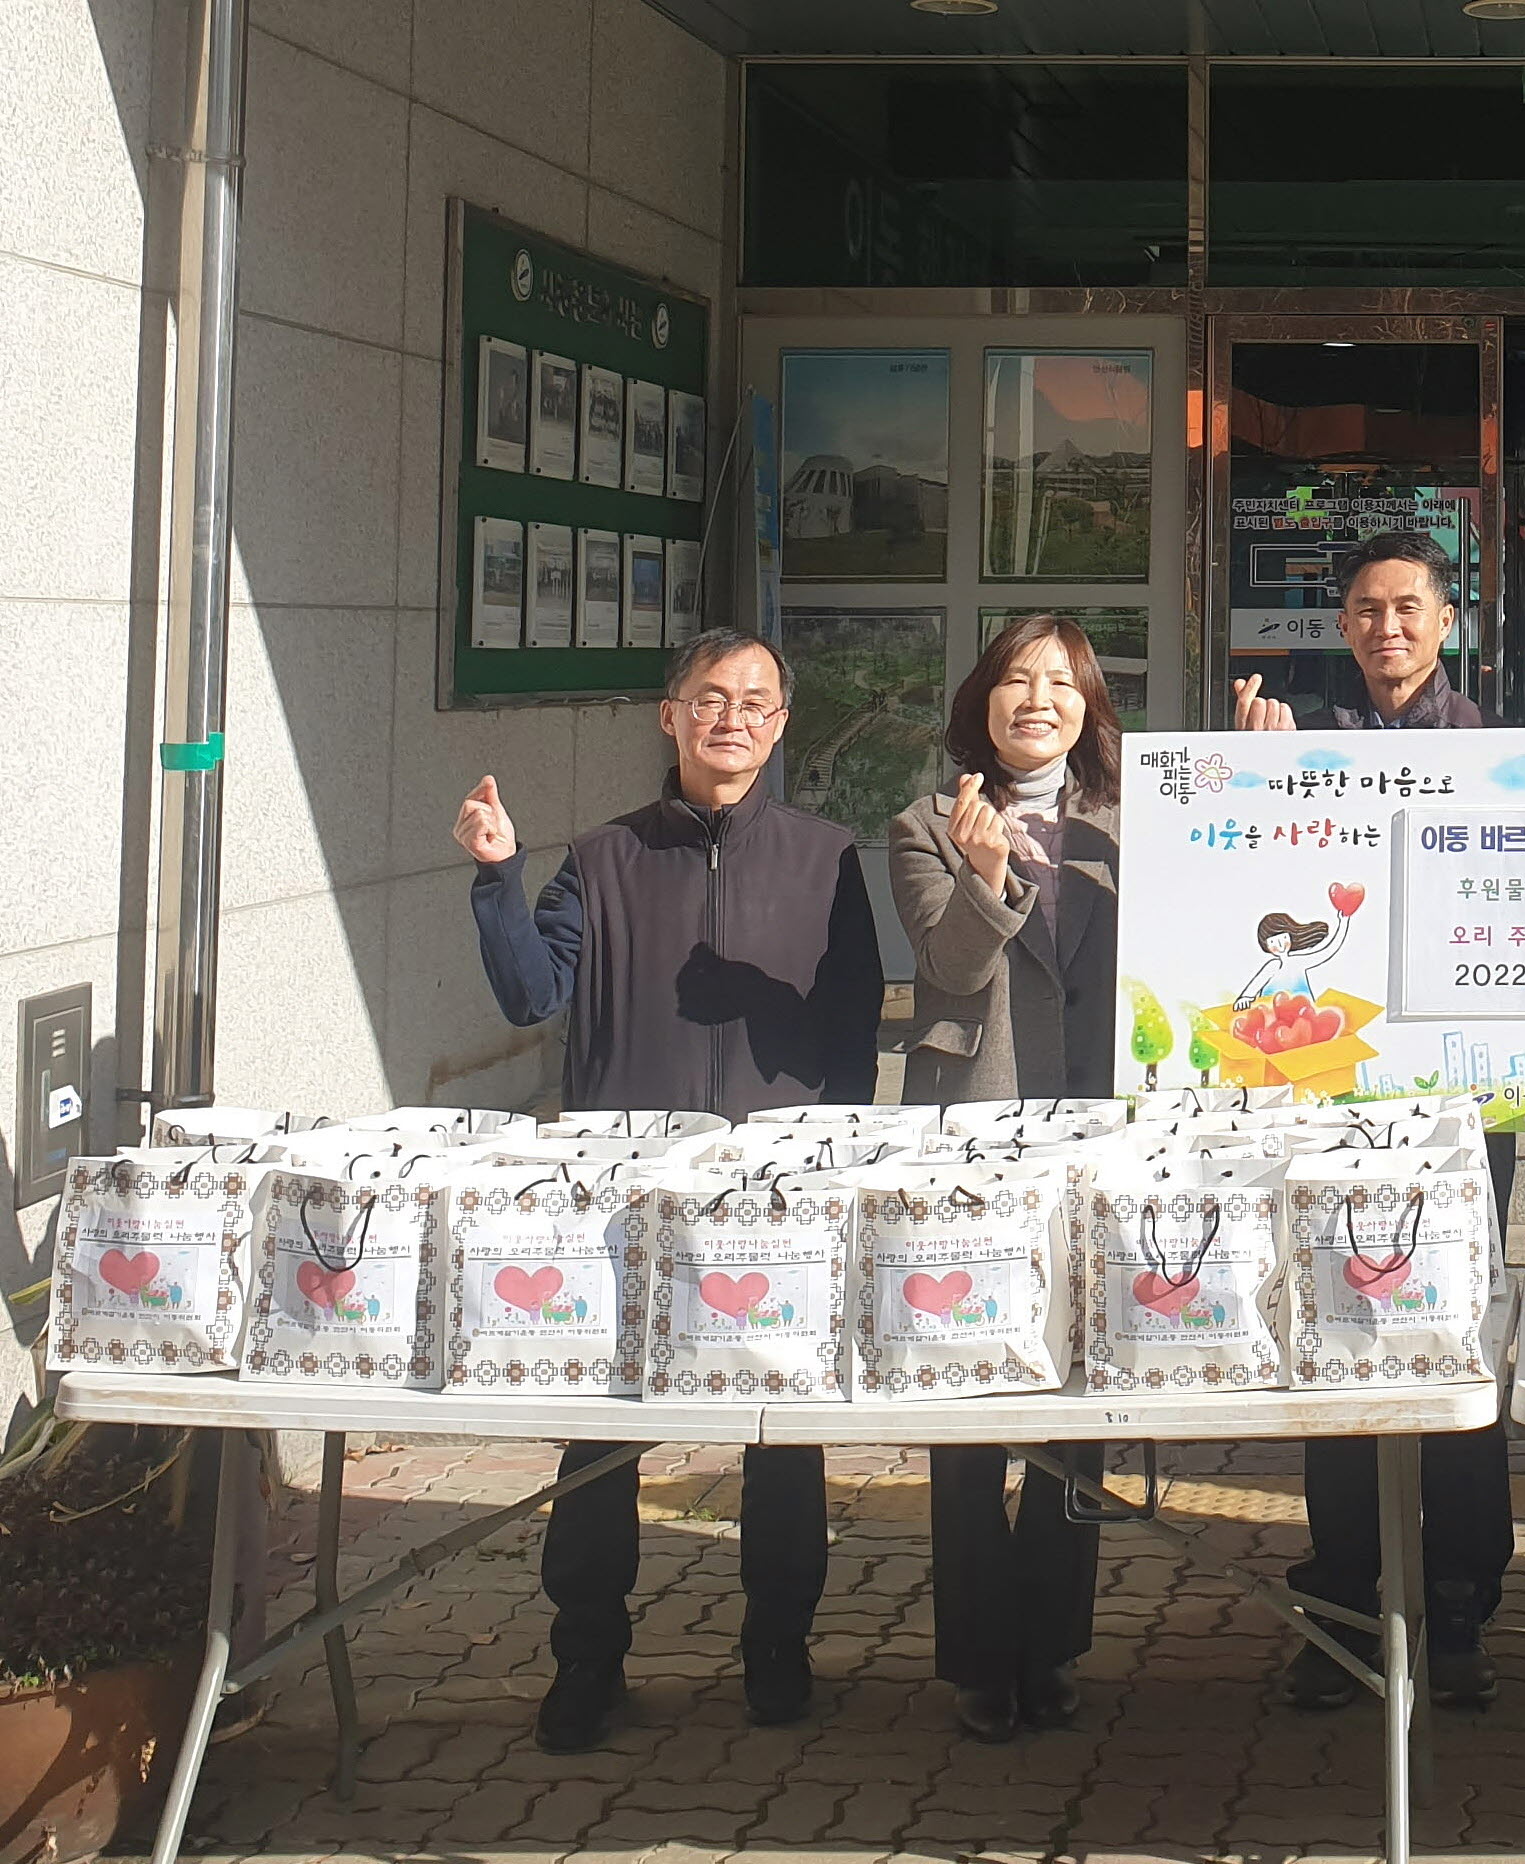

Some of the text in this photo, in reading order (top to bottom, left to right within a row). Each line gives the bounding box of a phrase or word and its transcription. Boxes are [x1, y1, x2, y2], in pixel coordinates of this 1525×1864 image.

[1232, 499, 1299, 513] 주민자치센터
[1304, 499, 1348, 512] 프로그램
[1234, 516, 1269, 529] 표시된
[1349, 516, 1403, 530] 이용하시기
[1287, 619, 1325, 638] 이동
[1140, 746, 1191, 768] 매화가
[1163, 768, 1192, 782] 피는
[1269, 767, 1455, 798] 따뜻한 마음으로
[1160, 782, 1197, 804] 이동
[1190, 818, 1381, 850] 이웃을 사랑하는
[1421, 825, 1469, 852] 이동
[1449, 926, 1492, 947] 오리
[82, 1229, 107, 1238] 사랑의
[1314, 1235, 1346, 1245] 사랑의
[279, 1238, 303, 1249] 사랑의
[470, 1246, 502, 1256] 사랑의
[675, 1251, 705, 1262] 사랑의
[877, 1252, 907, 1263] 사랑의
[1107, 1251, 1137, 1261] 사랑의
